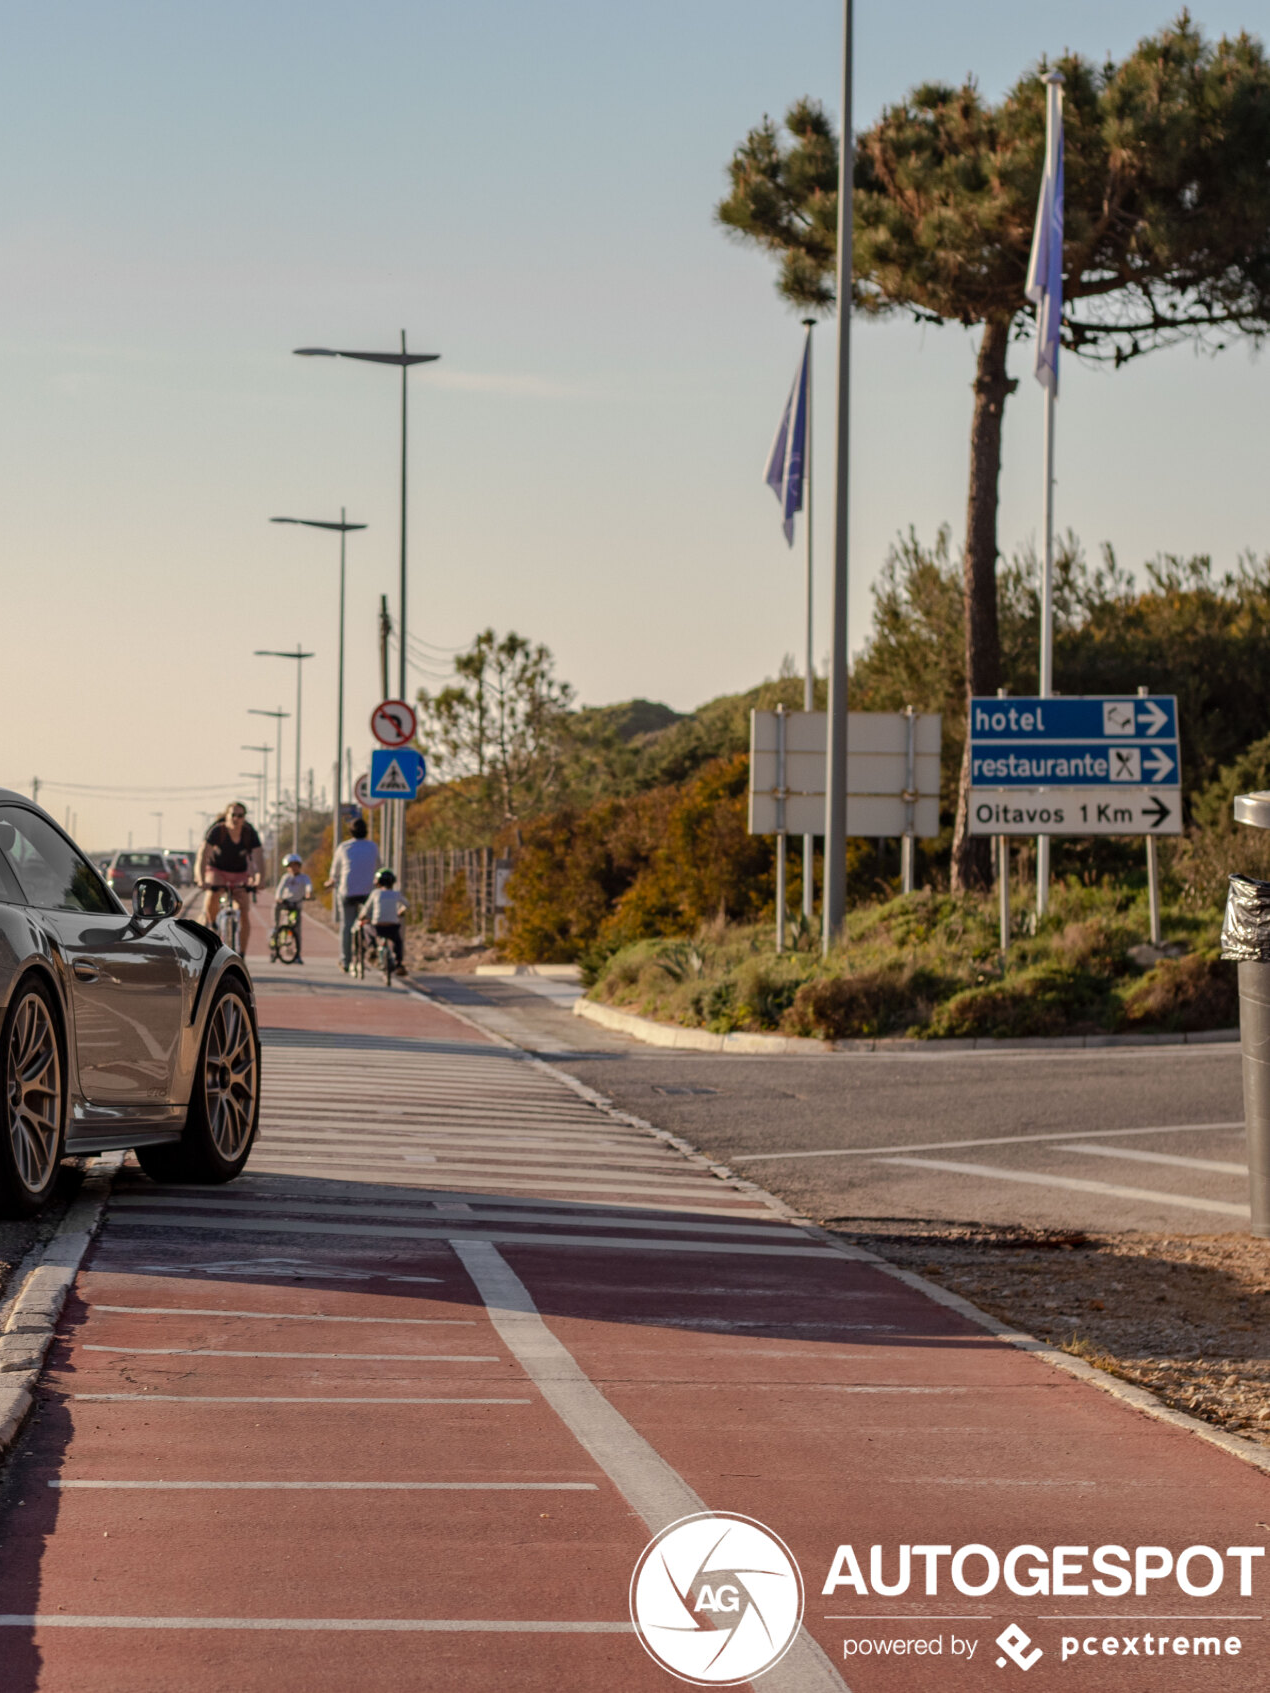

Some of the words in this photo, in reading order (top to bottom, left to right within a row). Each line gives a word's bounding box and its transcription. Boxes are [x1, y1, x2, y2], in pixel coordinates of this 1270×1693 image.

[975, 707, 1045, 731] hotel
[973, 753, 1108, 777] restaurante
[976, 803, 1065, 823] Oitavos
[1080, 804, 1088, 823] 1
[1097, 804, 1133, 823] Km
